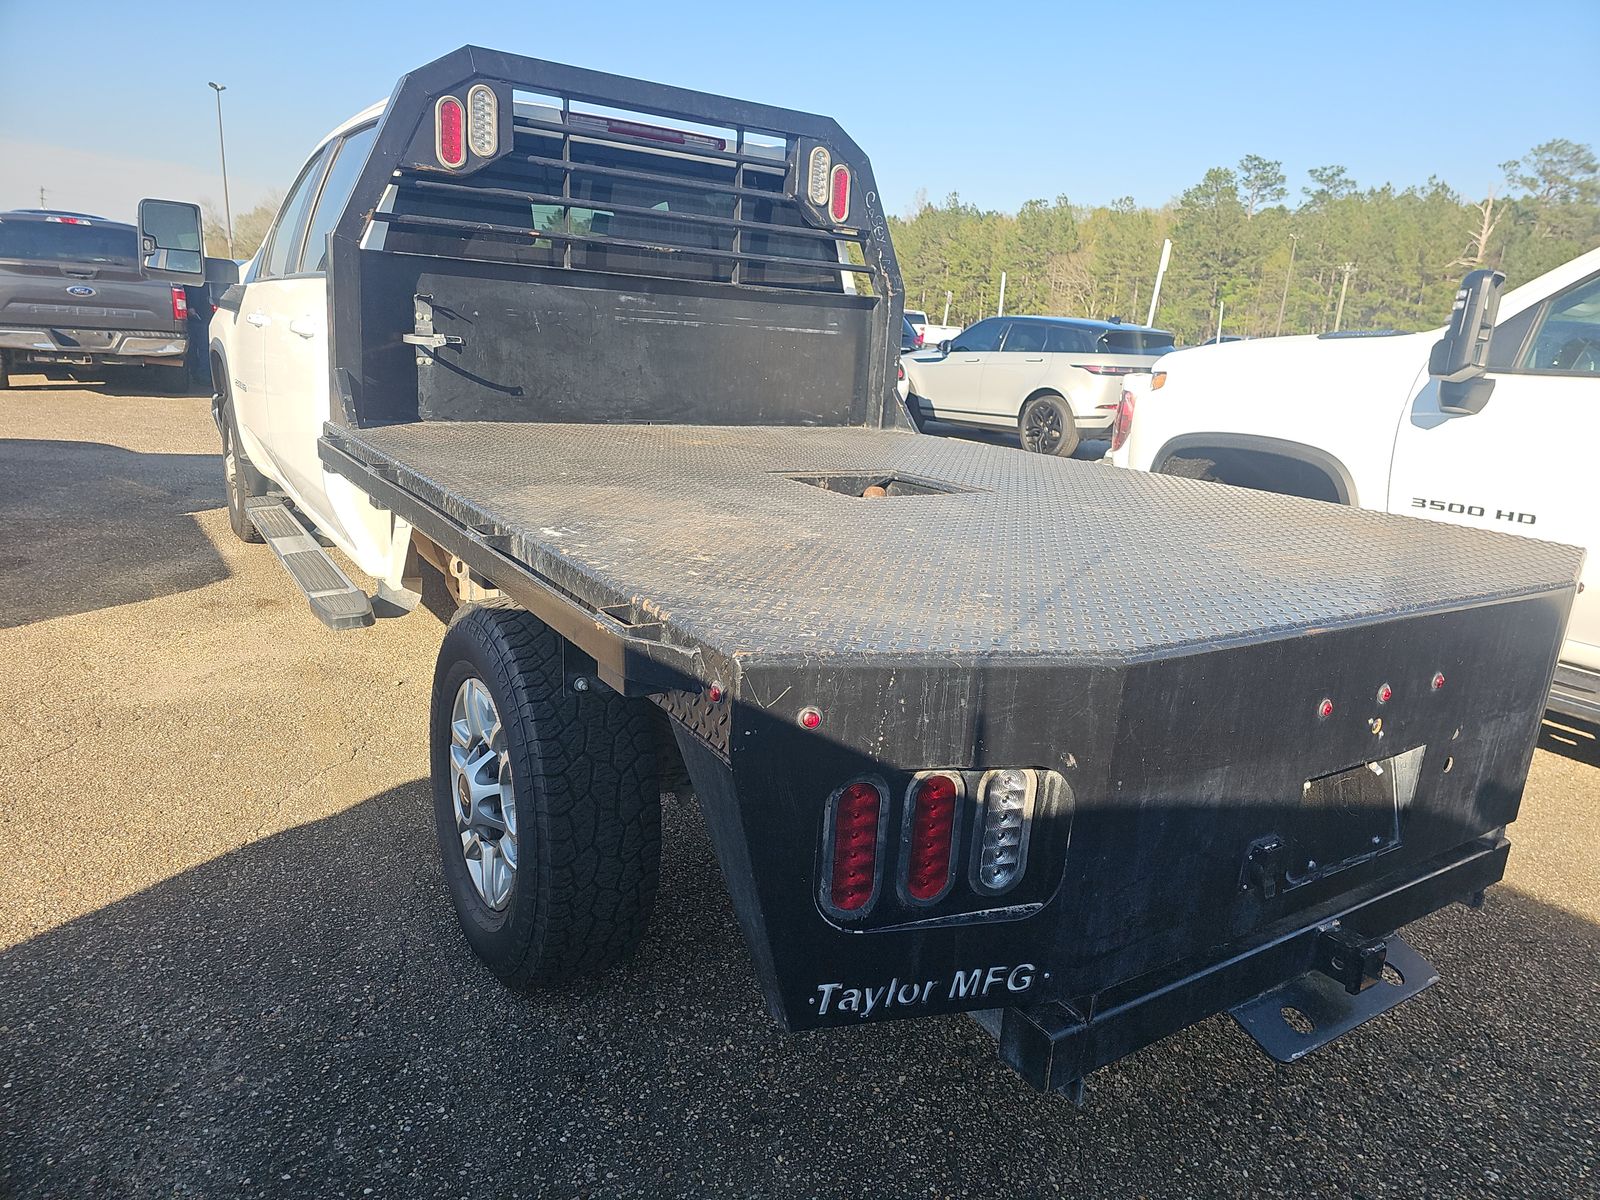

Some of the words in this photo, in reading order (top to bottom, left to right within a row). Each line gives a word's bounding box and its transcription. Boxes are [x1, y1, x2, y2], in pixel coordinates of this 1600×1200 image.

[1411, 497, 1485, 517] 3500
[1495, 509, 1536, 525] HD
[816, 977, 939, 1018] Taylor
[948, 963, 1036, 999] MFG
